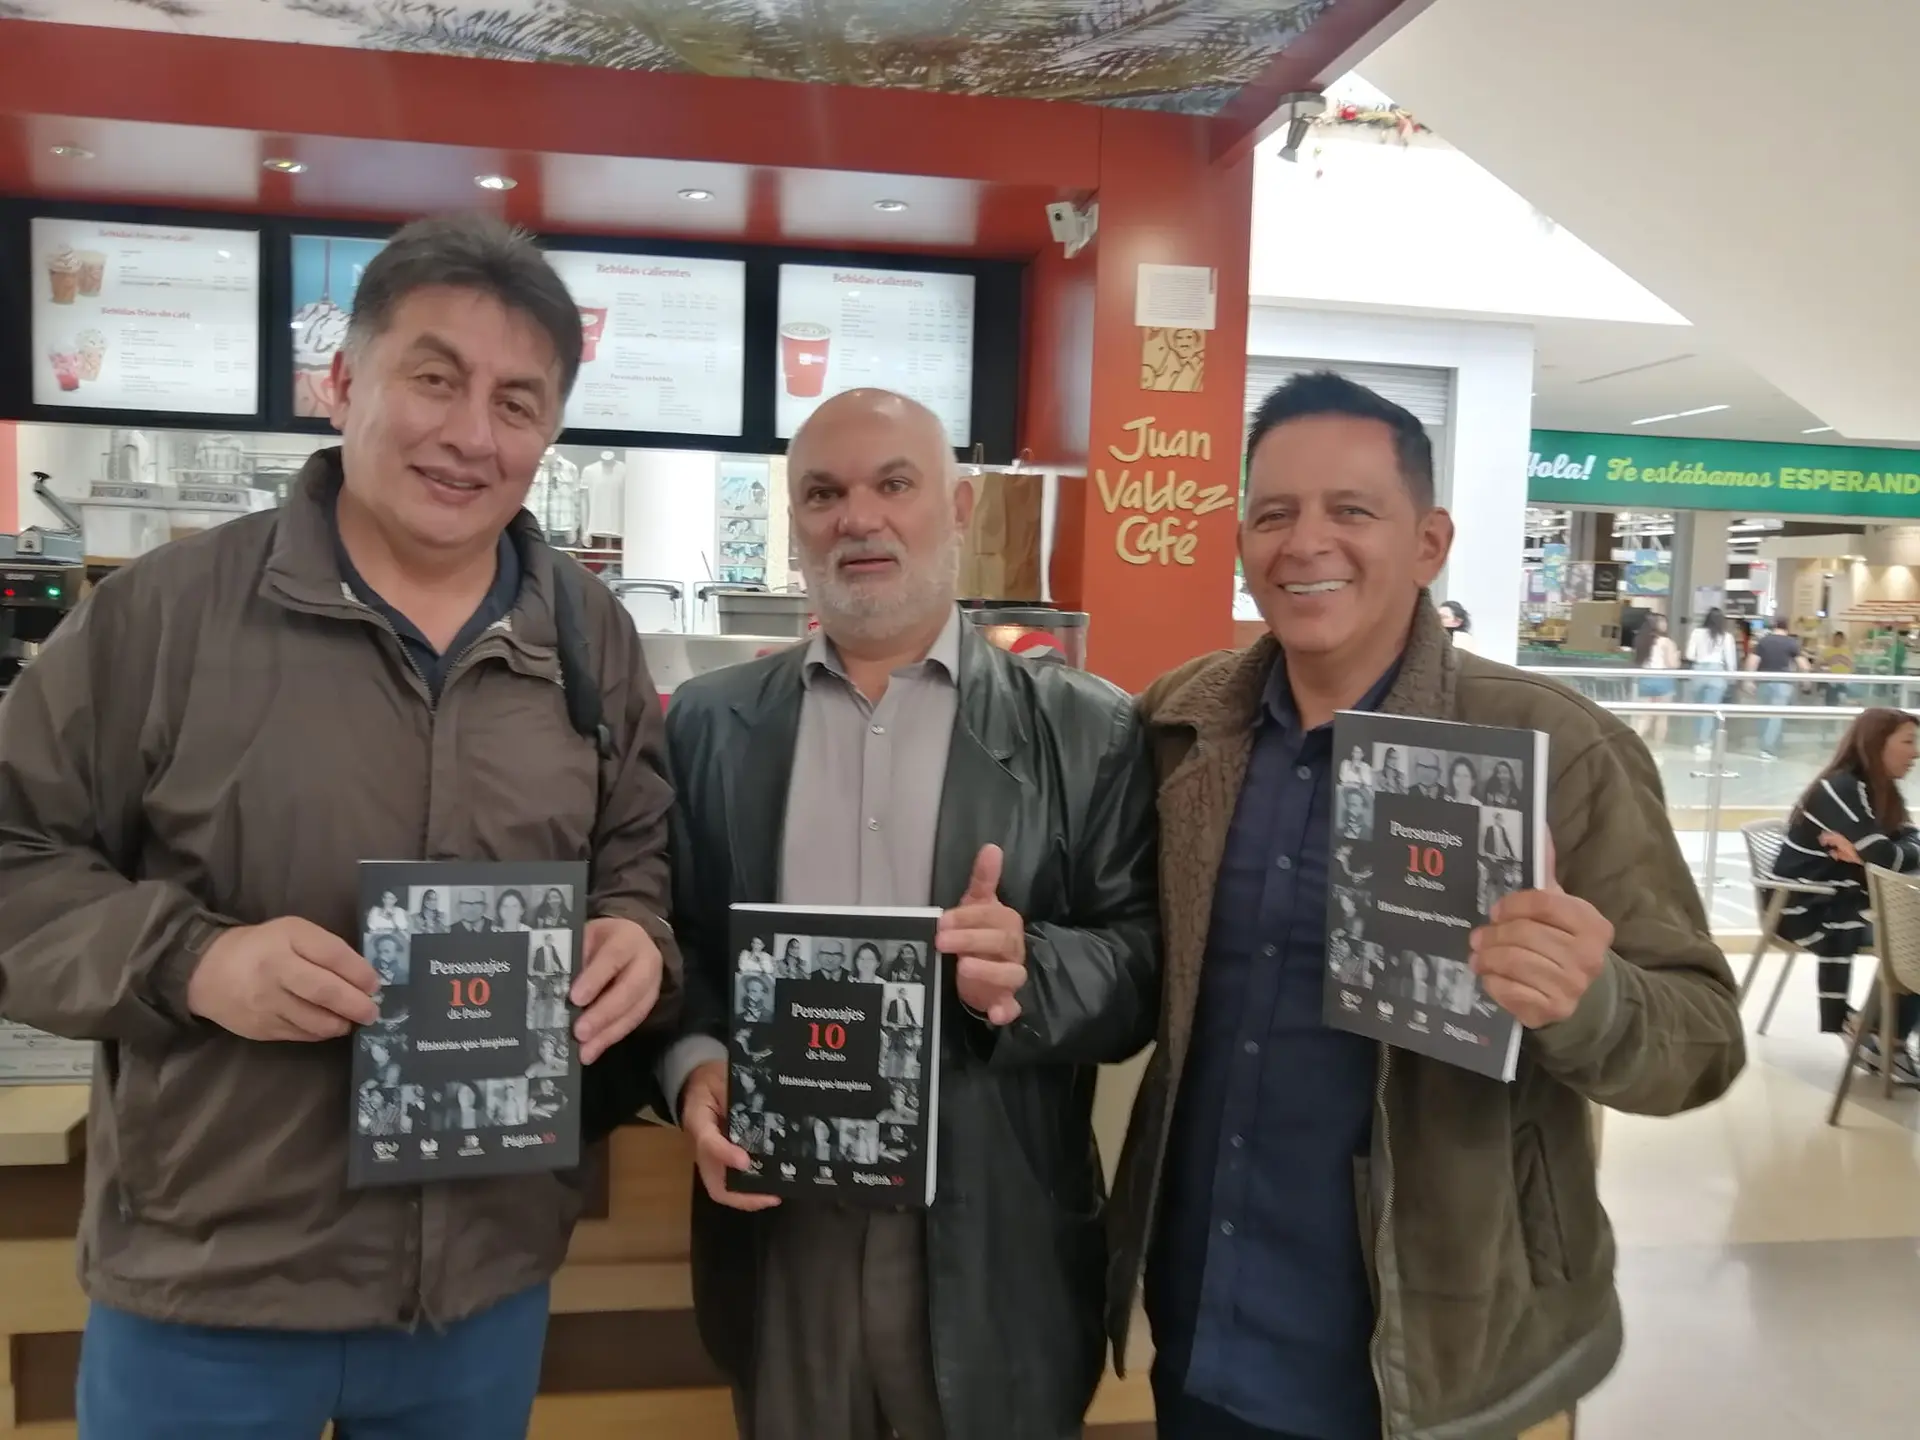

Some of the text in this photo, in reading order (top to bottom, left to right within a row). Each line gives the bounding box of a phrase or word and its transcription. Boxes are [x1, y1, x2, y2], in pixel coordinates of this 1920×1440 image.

[596, 264, 692, 278] Bebidas calientes
[833, 273, 924, 288] Bebidas calientes
[1108, 416, 1212, 463] Juan
[1606, 457, 1638, 482] Te
[1641, 460, 1775, 488] estábamos
[1779, 467, 1920, 495] ESPERAND
[1095, 469, 1235, 514] Valdez
[1115, 515, 1199, 565] Café
[1389, 820, 1463, 849] Personajes
[1406, 845, 1446, 876] 10
[1404, 873, 1418, 887] de
[429, 958, 511, 977] Personajes
[448, 976, 491, 1007] 10
[446, 1007, 461, 1020] de
[791, 1002, 866, 1025] Personajes
[808, 1022, 846, 1050] 10
[805, 1047, 819, 1061] de
